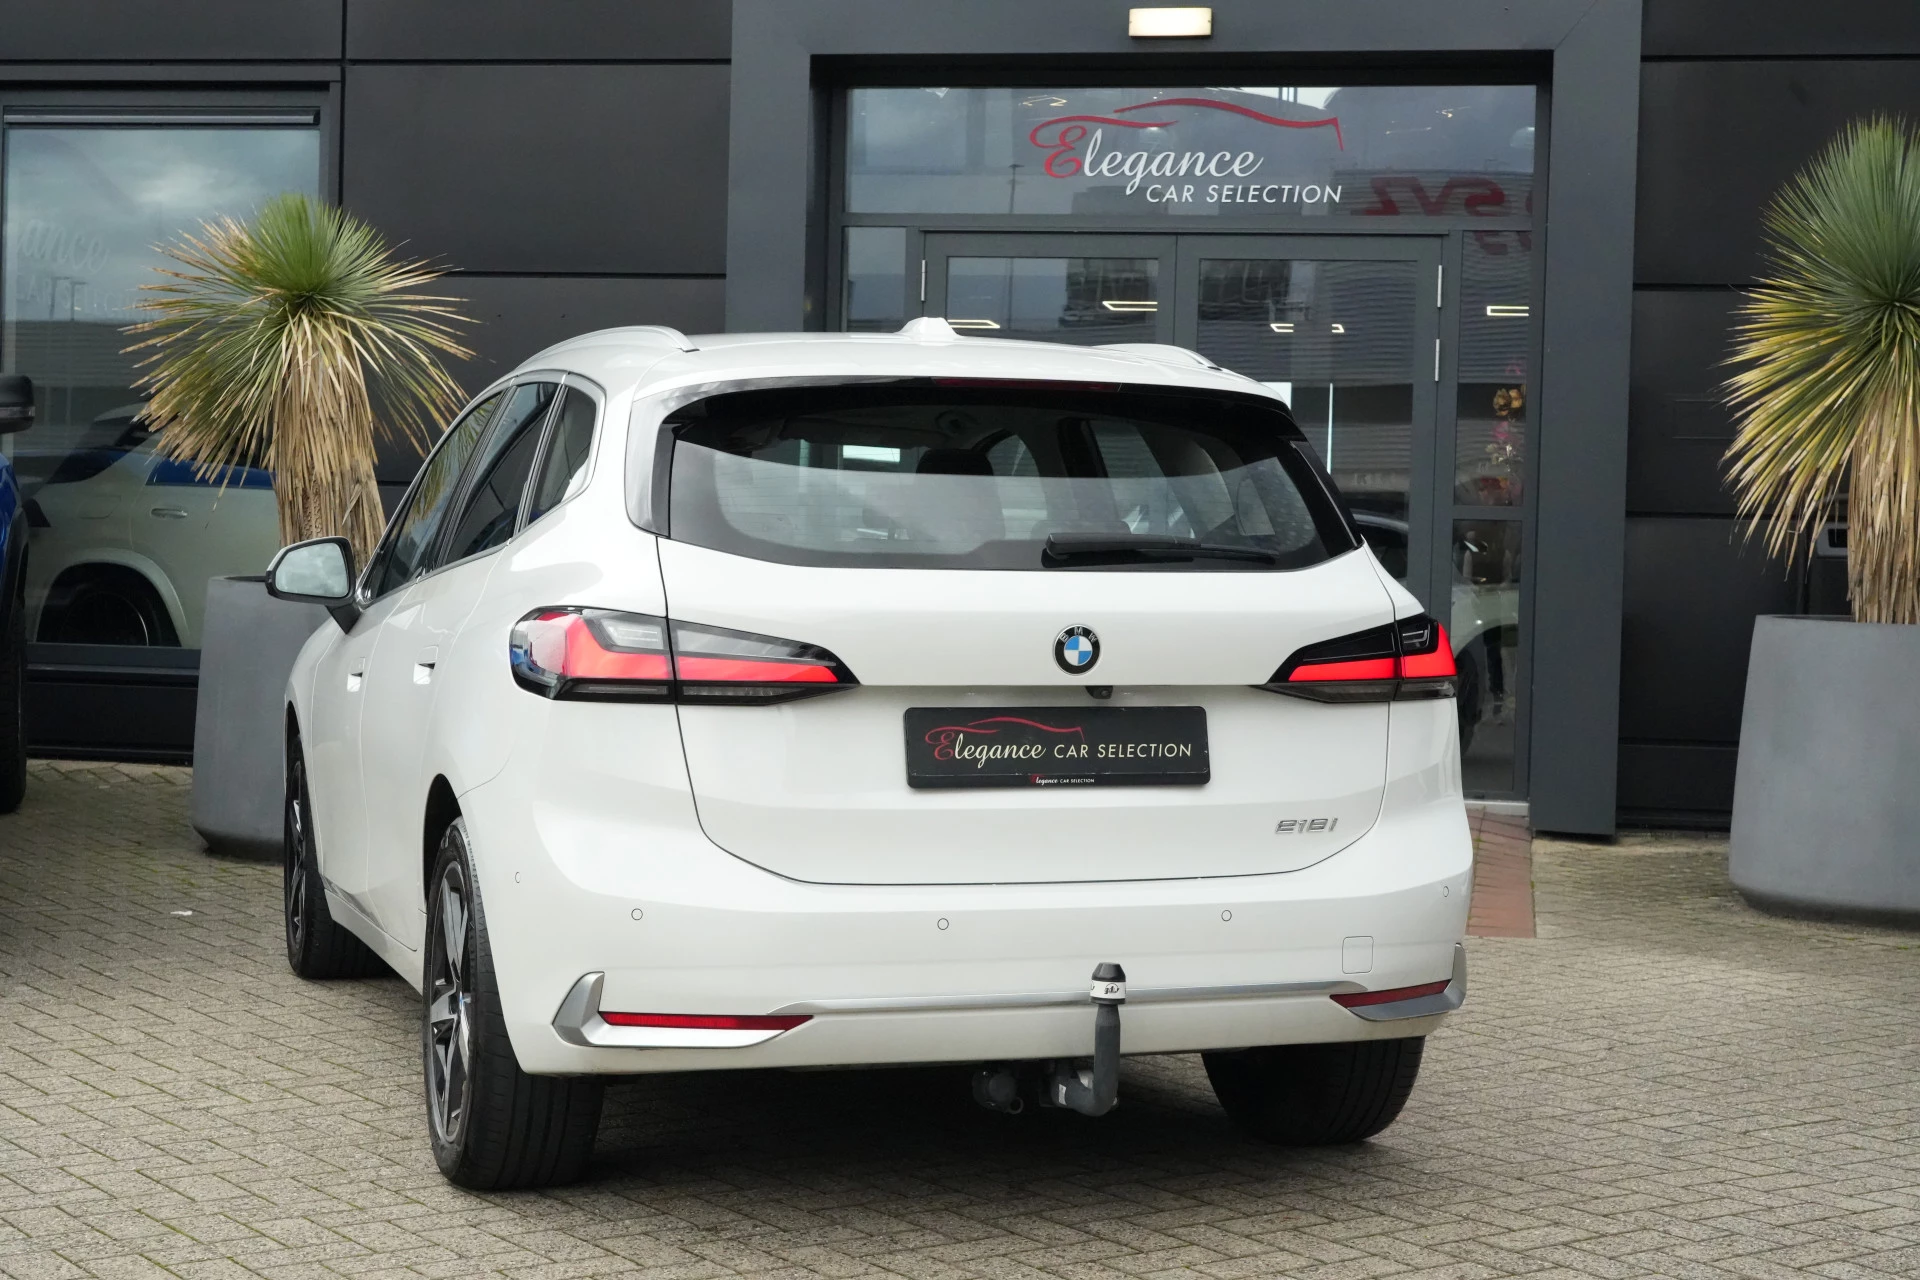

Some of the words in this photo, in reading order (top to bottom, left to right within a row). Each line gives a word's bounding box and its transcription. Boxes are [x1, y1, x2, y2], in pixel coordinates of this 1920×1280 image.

[1029, 115, 1264, 196] Elegance
[1145, 184, 1194, 203] CAR
[1205, 184, 1342, 204] SELECTION
[925, 726, 1046, 768] Elegance
[1053, 743, 1089, 758] CAR
[1097, 743, 1192, 758] SELECTION
[1275, 817, 1339, 833] 218i
